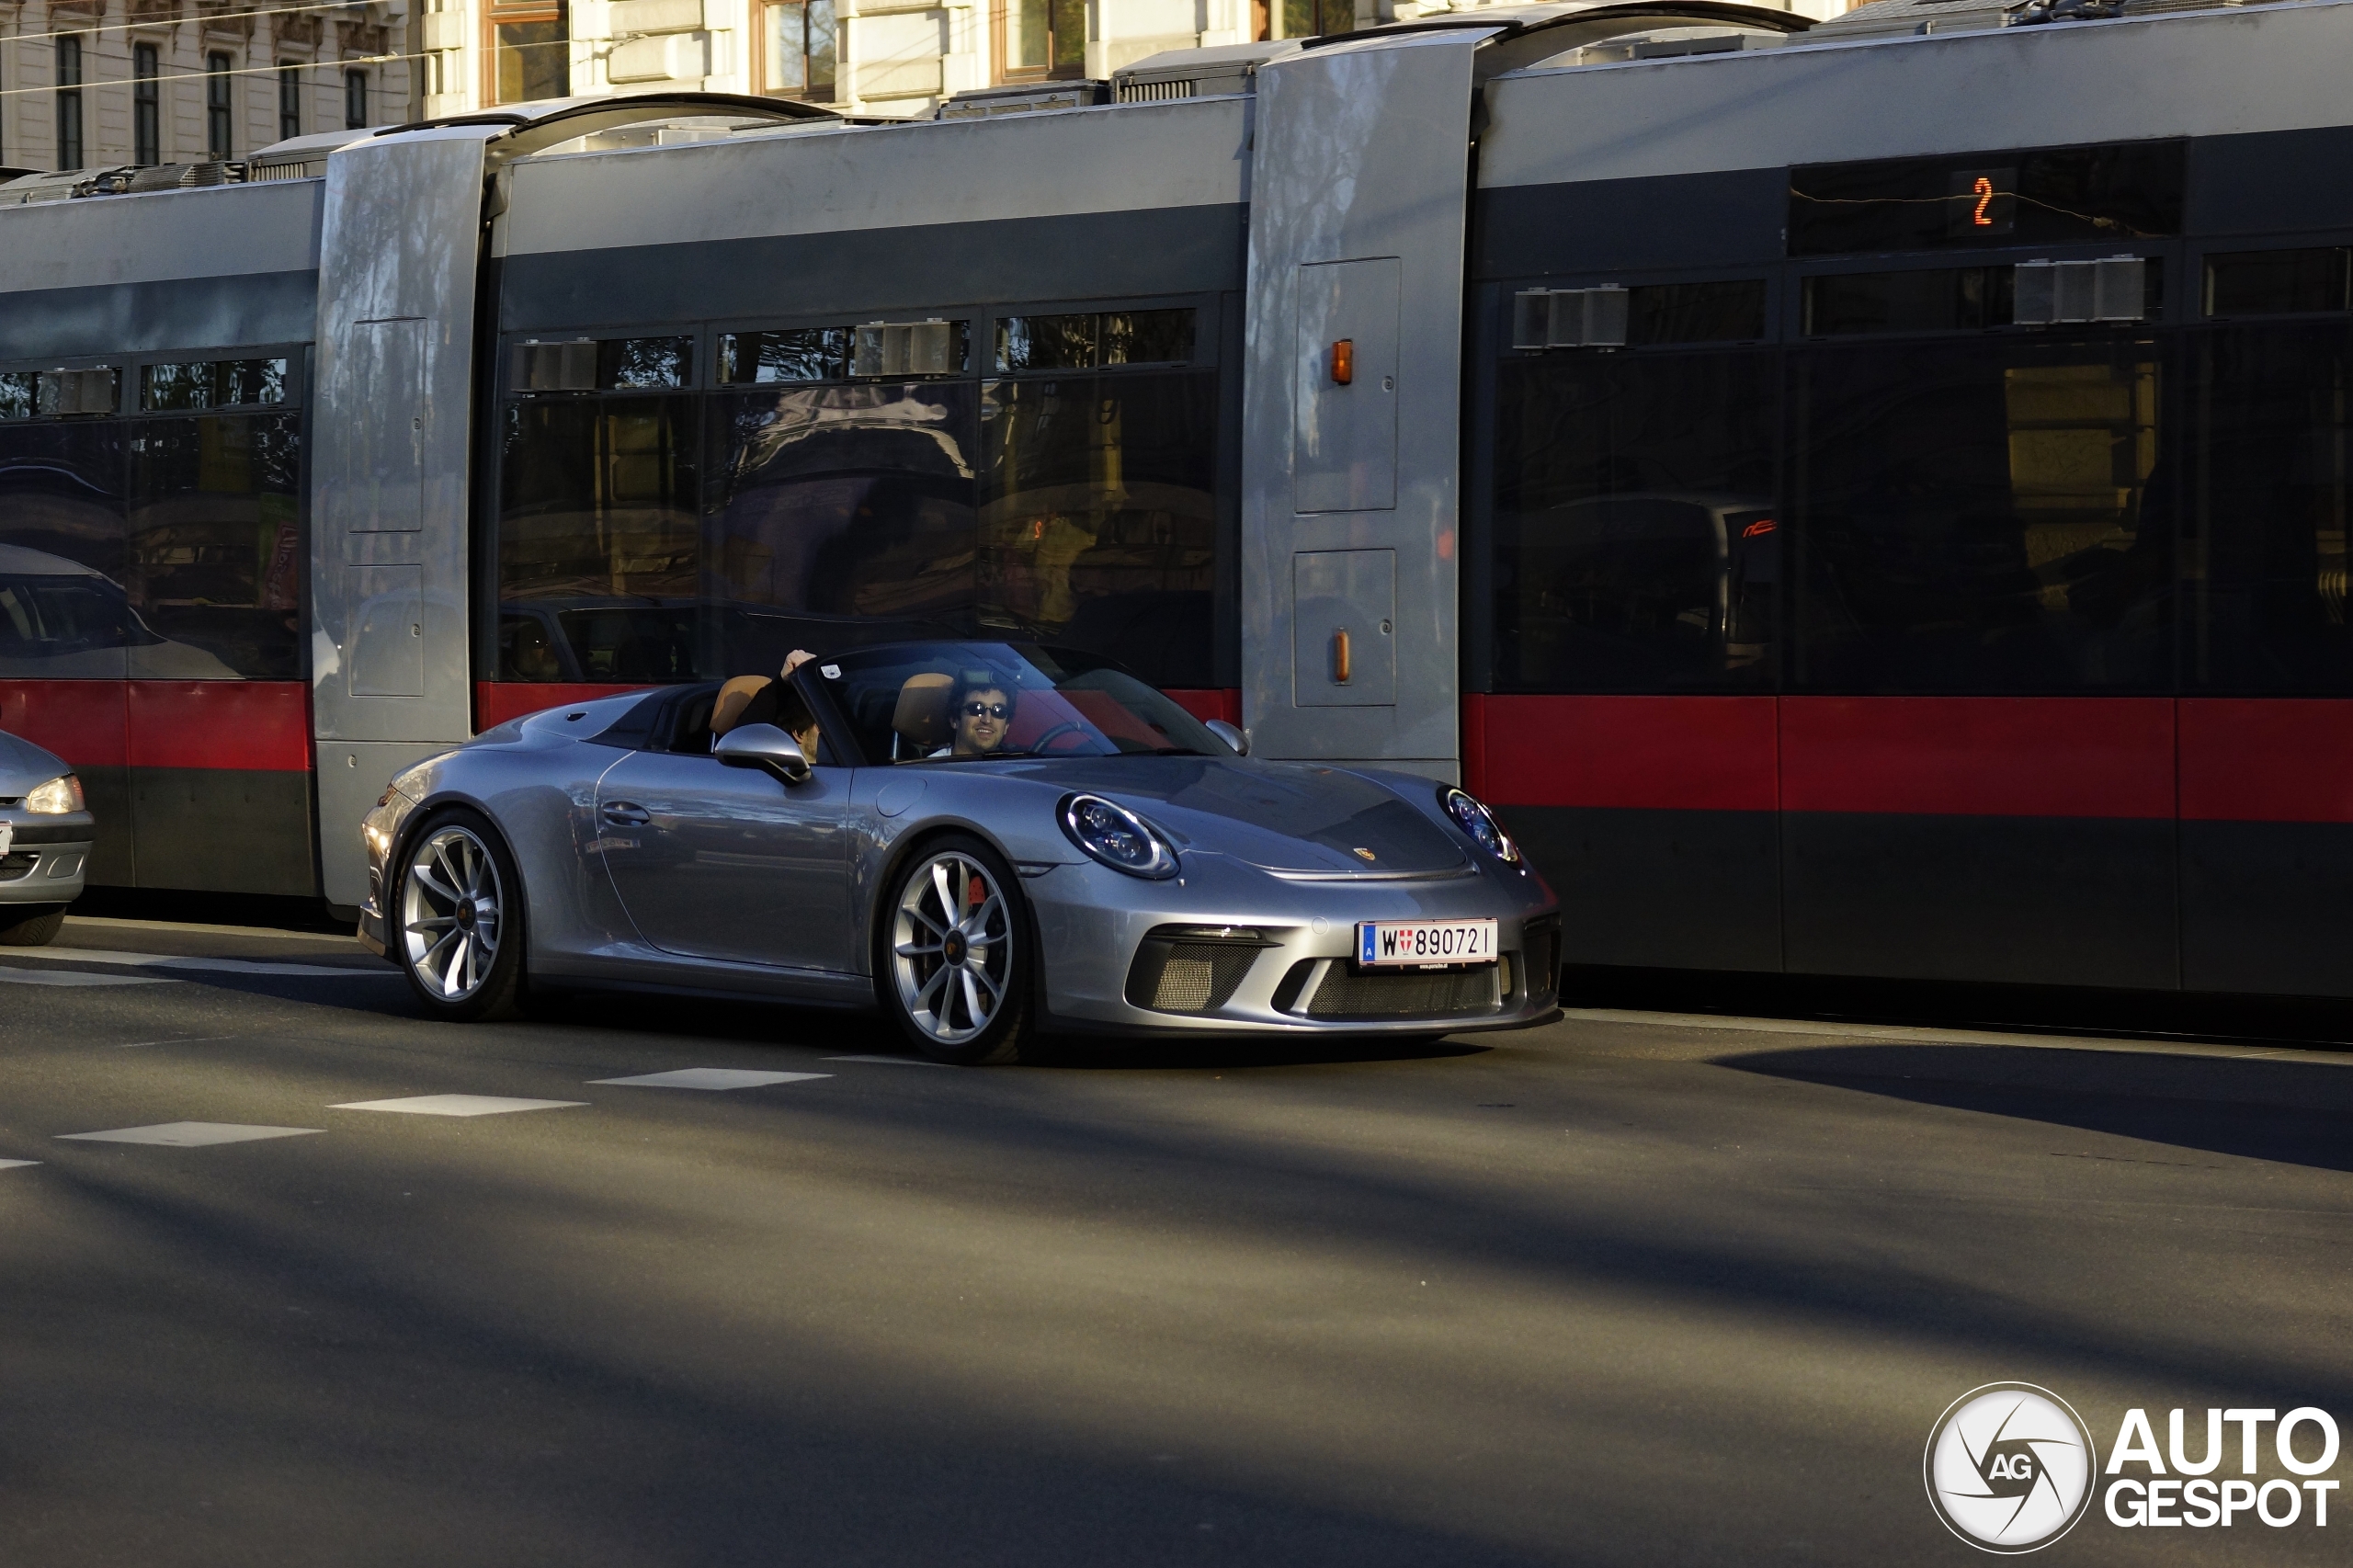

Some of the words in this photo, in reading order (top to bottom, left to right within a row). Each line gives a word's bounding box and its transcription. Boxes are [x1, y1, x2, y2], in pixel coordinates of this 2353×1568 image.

[1974, 177, 1992, 225] 2
[1366, 947, 1372, 957] A
[1382, 929, 1398, 956] W
